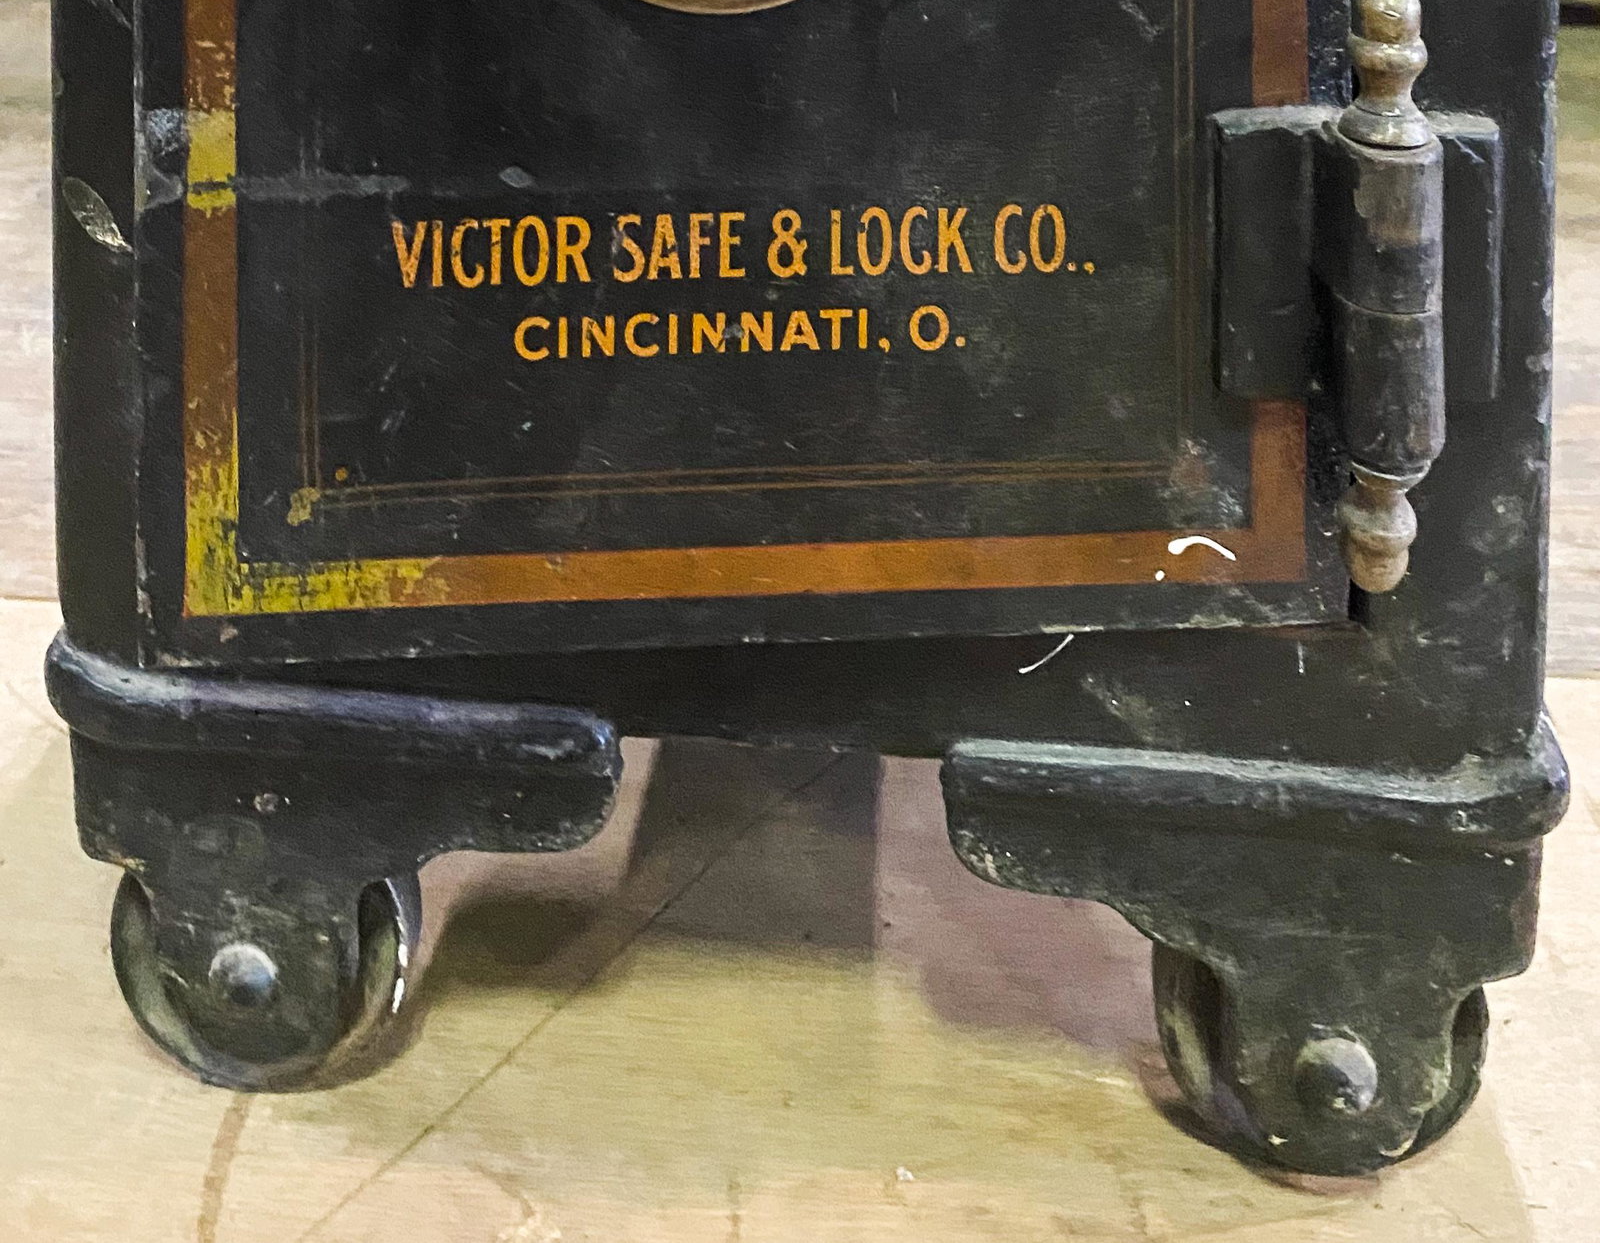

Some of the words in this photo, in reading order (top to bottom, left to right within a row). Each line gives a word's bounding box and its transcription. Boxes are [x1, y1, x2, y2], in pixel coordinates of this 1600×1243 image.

[391, 215, 594, 290] VICTOR
[611, 211, 747, 284] SAFE
[766, 208, 810, 279] &
[829, 204, 975, 278] LOCK
[513, 306, 892, 362] CINCINNATI,
[907, 303, 969, 352] O.
